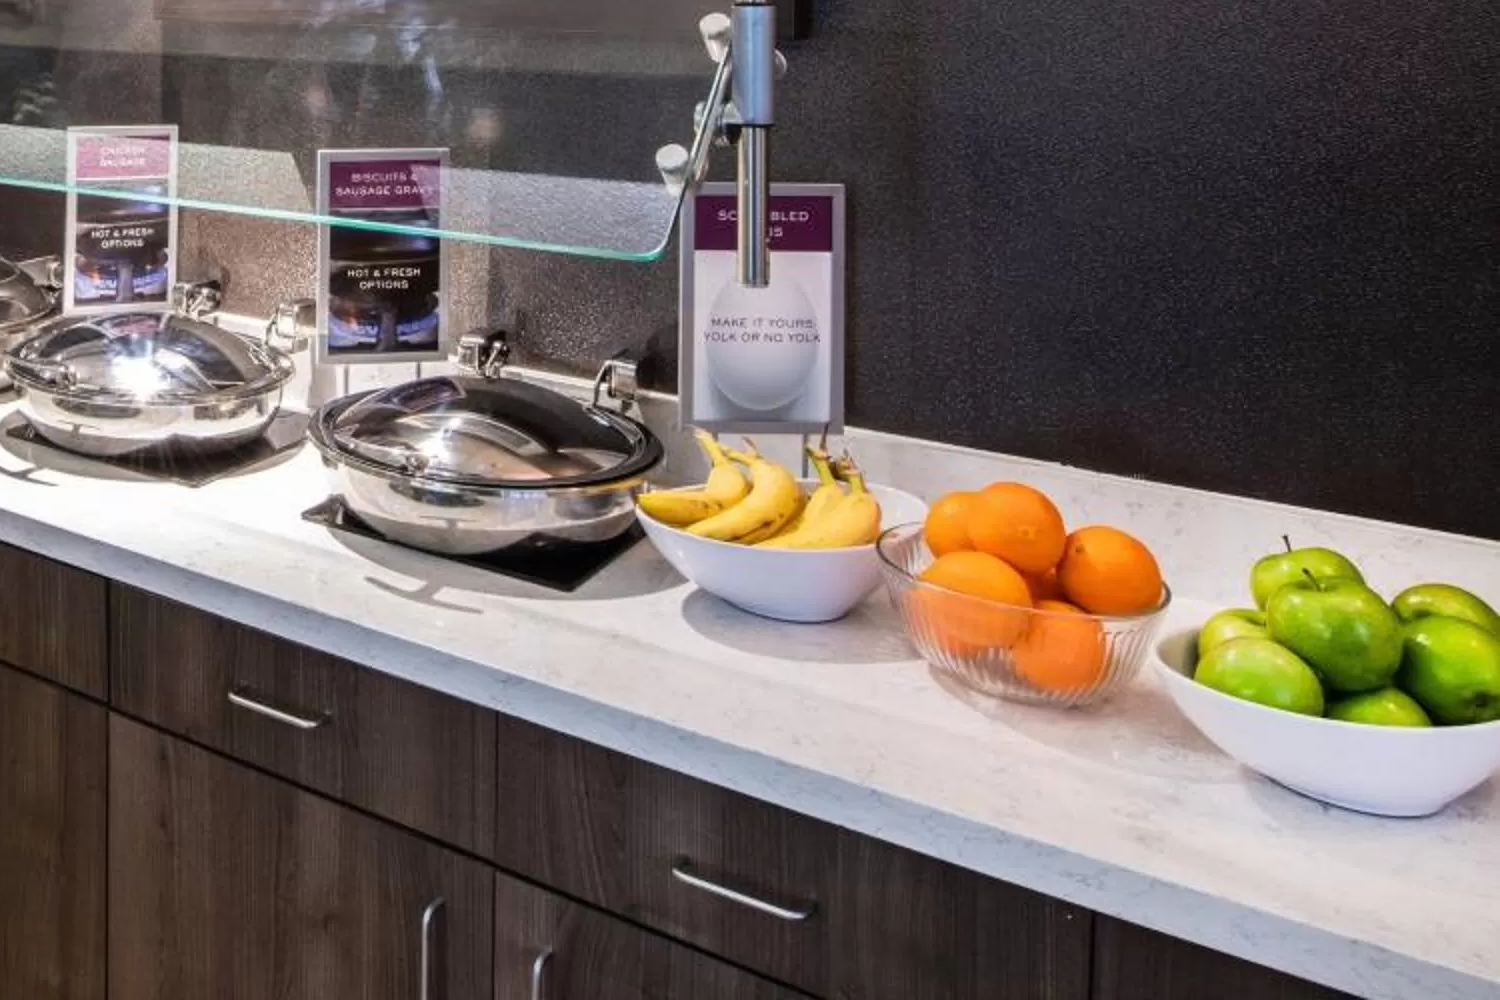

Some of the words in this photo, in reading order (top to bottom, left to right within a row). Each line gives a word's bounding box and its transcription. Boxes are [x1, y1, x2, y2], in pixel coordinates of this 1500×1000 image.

[351, 172, 407, 182] BISCUITS
[335, 186, 391, 196] SAUSAGE
[717, 210, 810, 222] SCBLED
[91, 229, 111, 239] HOT
[122, 227, 155, 237] FRESH
[101, 239, 145, 249] OPTIONS
[347, 268, 369, 278] HOT
[383, 267, 421, 277] FRESH
[359, 279, 409, 290] OPTIONS
[711, 317, 747, 328] MAKE
[752, 318, 763, 327] IT
[703, 331, 737, 342] YOLK
[740, 332, 760, 342] OR
[762, 332, 784, 342] NO
[787, 332, 821, 342] YOLK
